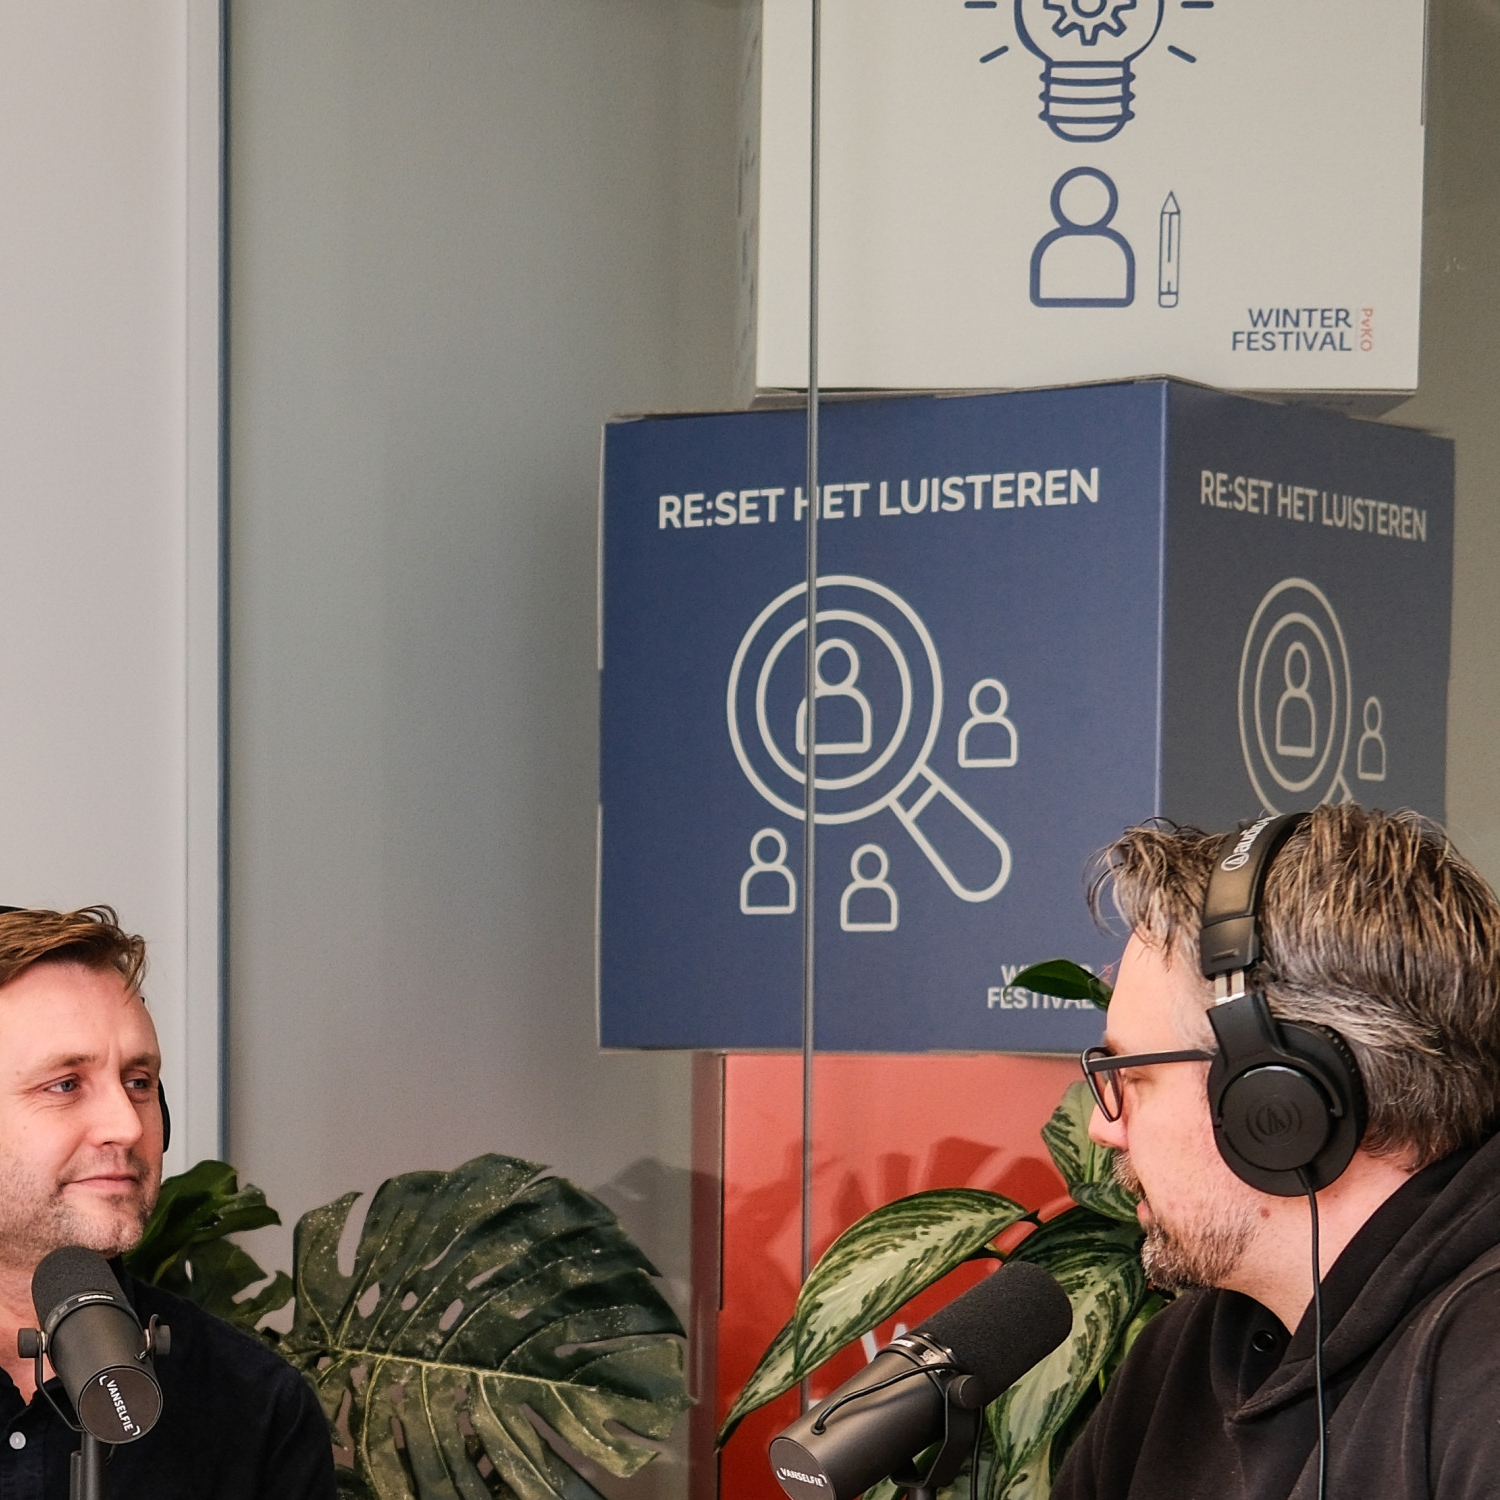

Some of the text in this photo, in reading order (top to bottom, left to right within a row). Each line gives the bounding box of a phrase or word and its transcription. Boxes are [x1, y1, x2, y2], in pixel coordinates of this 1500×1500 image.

[1248, 308, 1352, 328] WINTER
[1360, 308, 1374, 352] PvKO
[1232, 331, 1352, 351] FESTIVAL
[658, 467, 1099, 529] RE:SET HET LUISTEREN
[1200, 470, 1427, 542] RE:SET HET LUISTEREN
[106, 1379, 134, 1432] VANSELFIE
[780, 1467, 824, 1487] VANSELFIE
